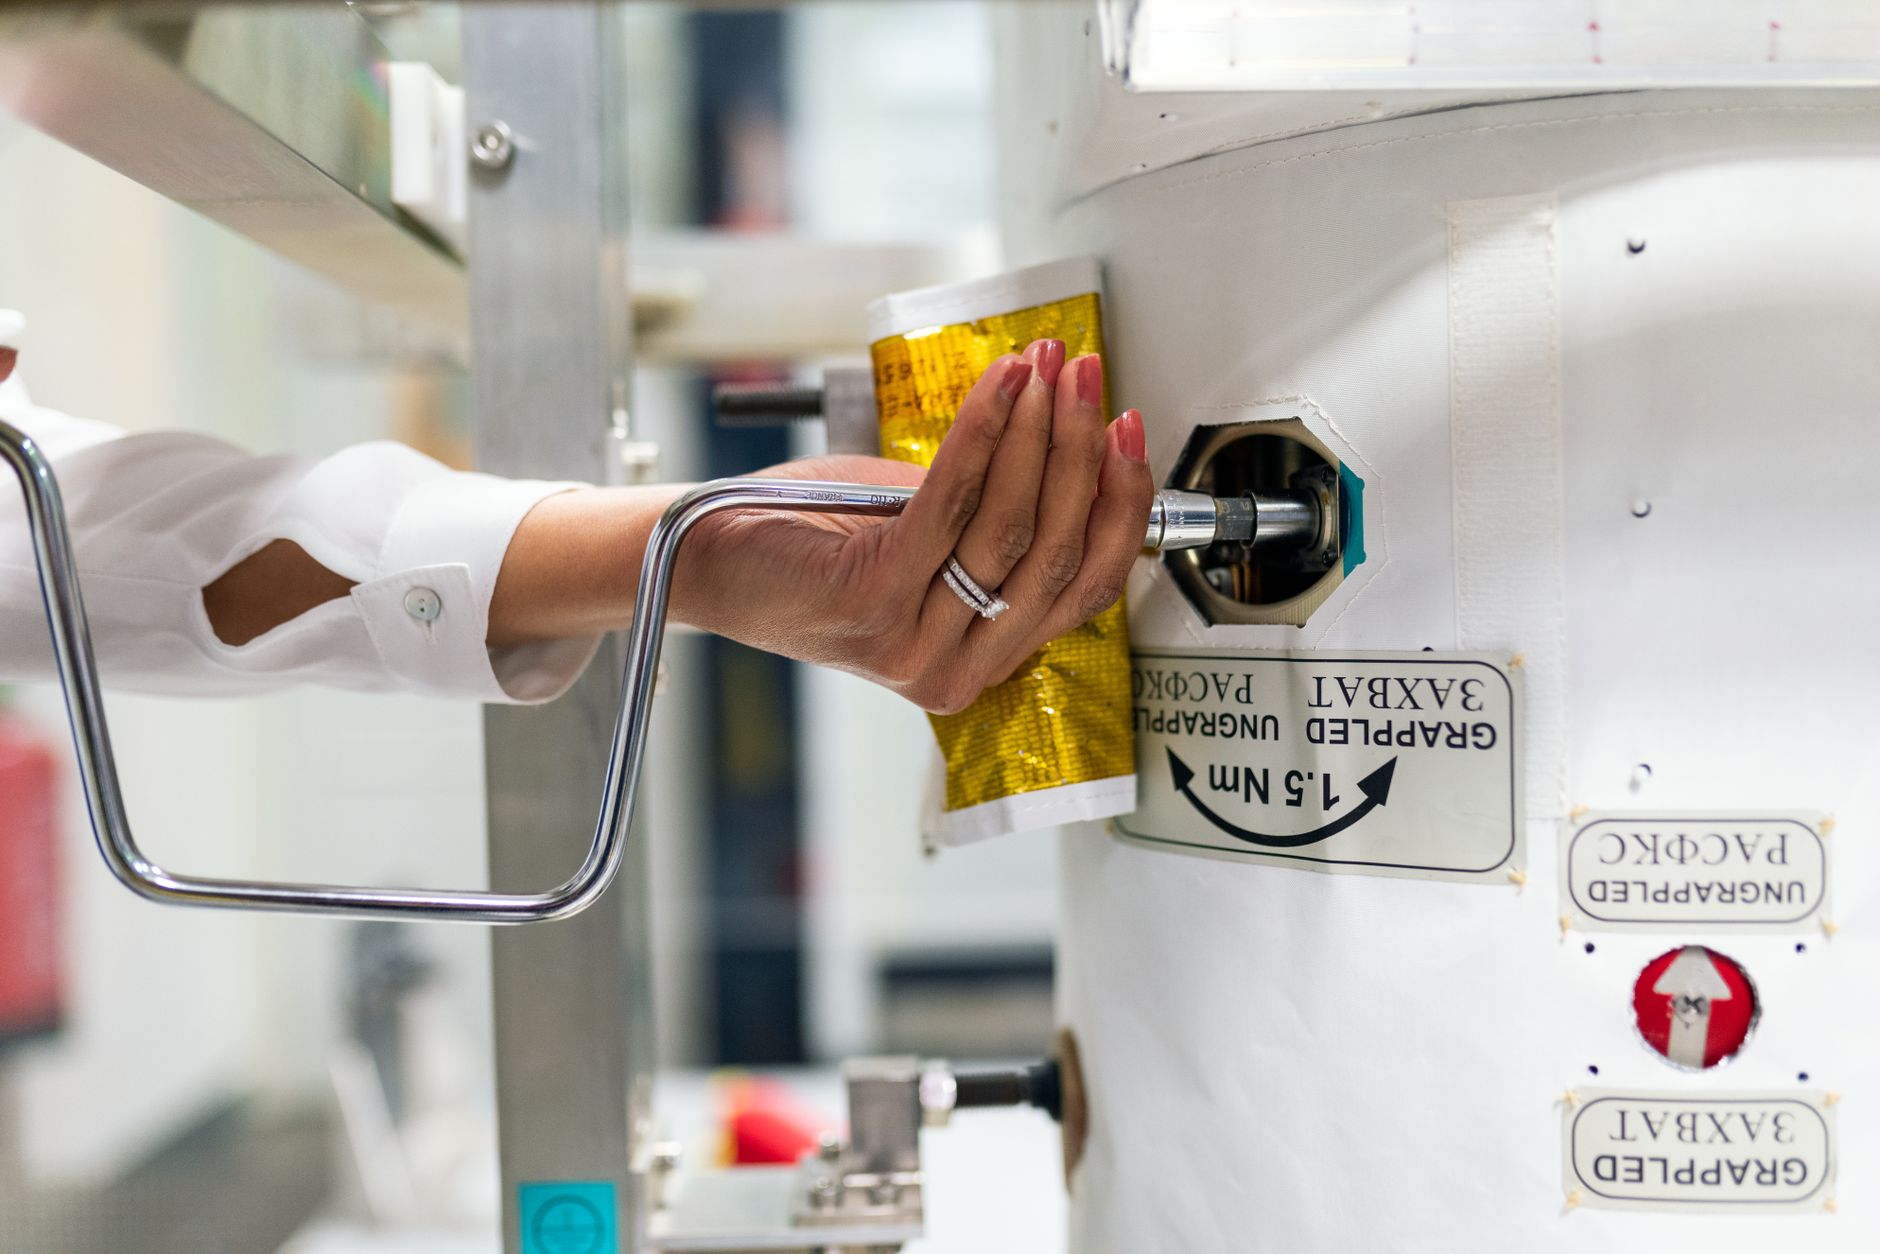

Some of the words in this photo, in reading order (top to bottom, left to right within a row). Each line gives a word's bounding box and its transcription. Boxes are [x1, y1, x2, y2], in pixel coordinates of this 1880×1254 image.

[1307, 675, 1486, 711] ЗАХВАТ
[1306, 717, 1497, 750] GRAPPLED
[1208, 764, 1270, 806] Nm
[1284, 768, 1341, 811] 1.5
[1598, 833, 1790, 866] РАСФКС
[1588, 880, 1806, 904] UNGRAPPLED
[1608, 1110, 1796, 1145] ЗАХВАТ
[1593, 1154, 1808, 1187] GRAPPLED
